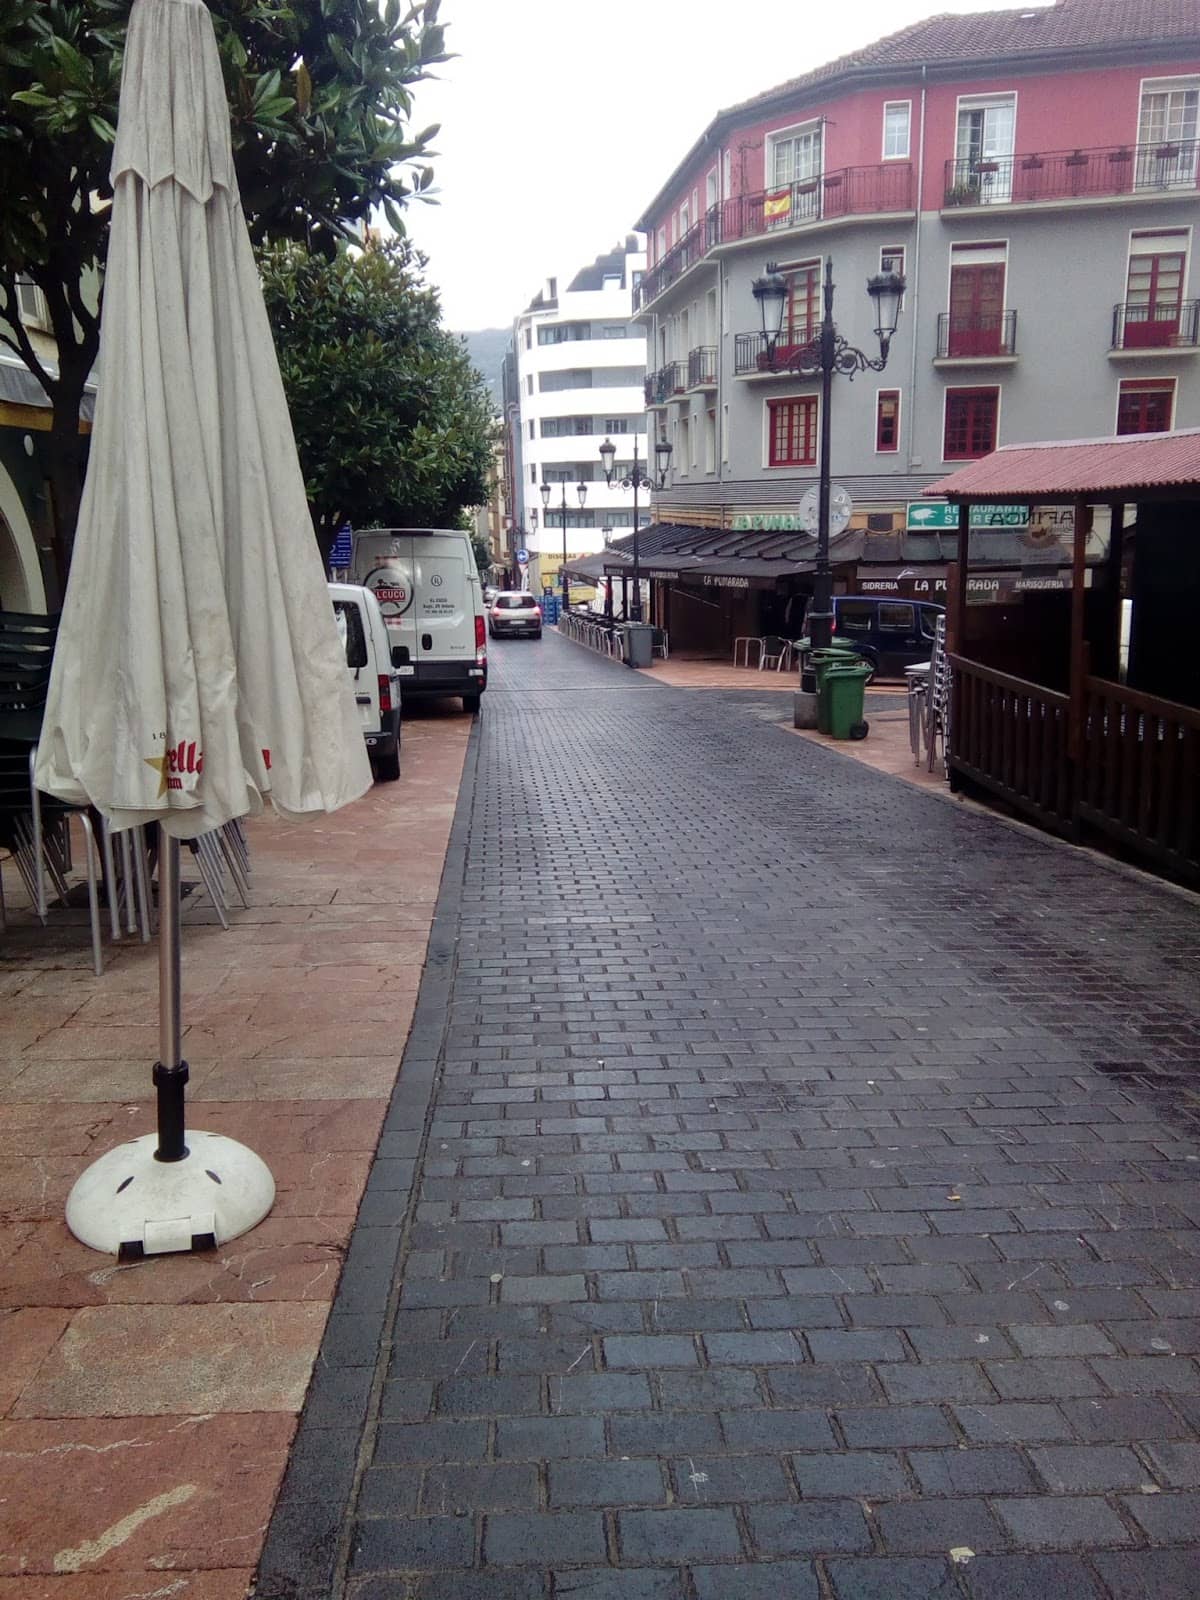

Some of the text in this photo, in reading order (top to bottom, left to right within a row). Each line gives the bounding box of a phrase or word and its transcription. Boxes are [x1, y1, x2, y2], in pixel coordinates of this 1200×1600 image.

[944, 505, 1028, 514] REAURANTE
[861, 581, 899, 591] SIDRERIA
[914, 580, 929, 591] LA
[935, 580, 1000, 592] PURADA
